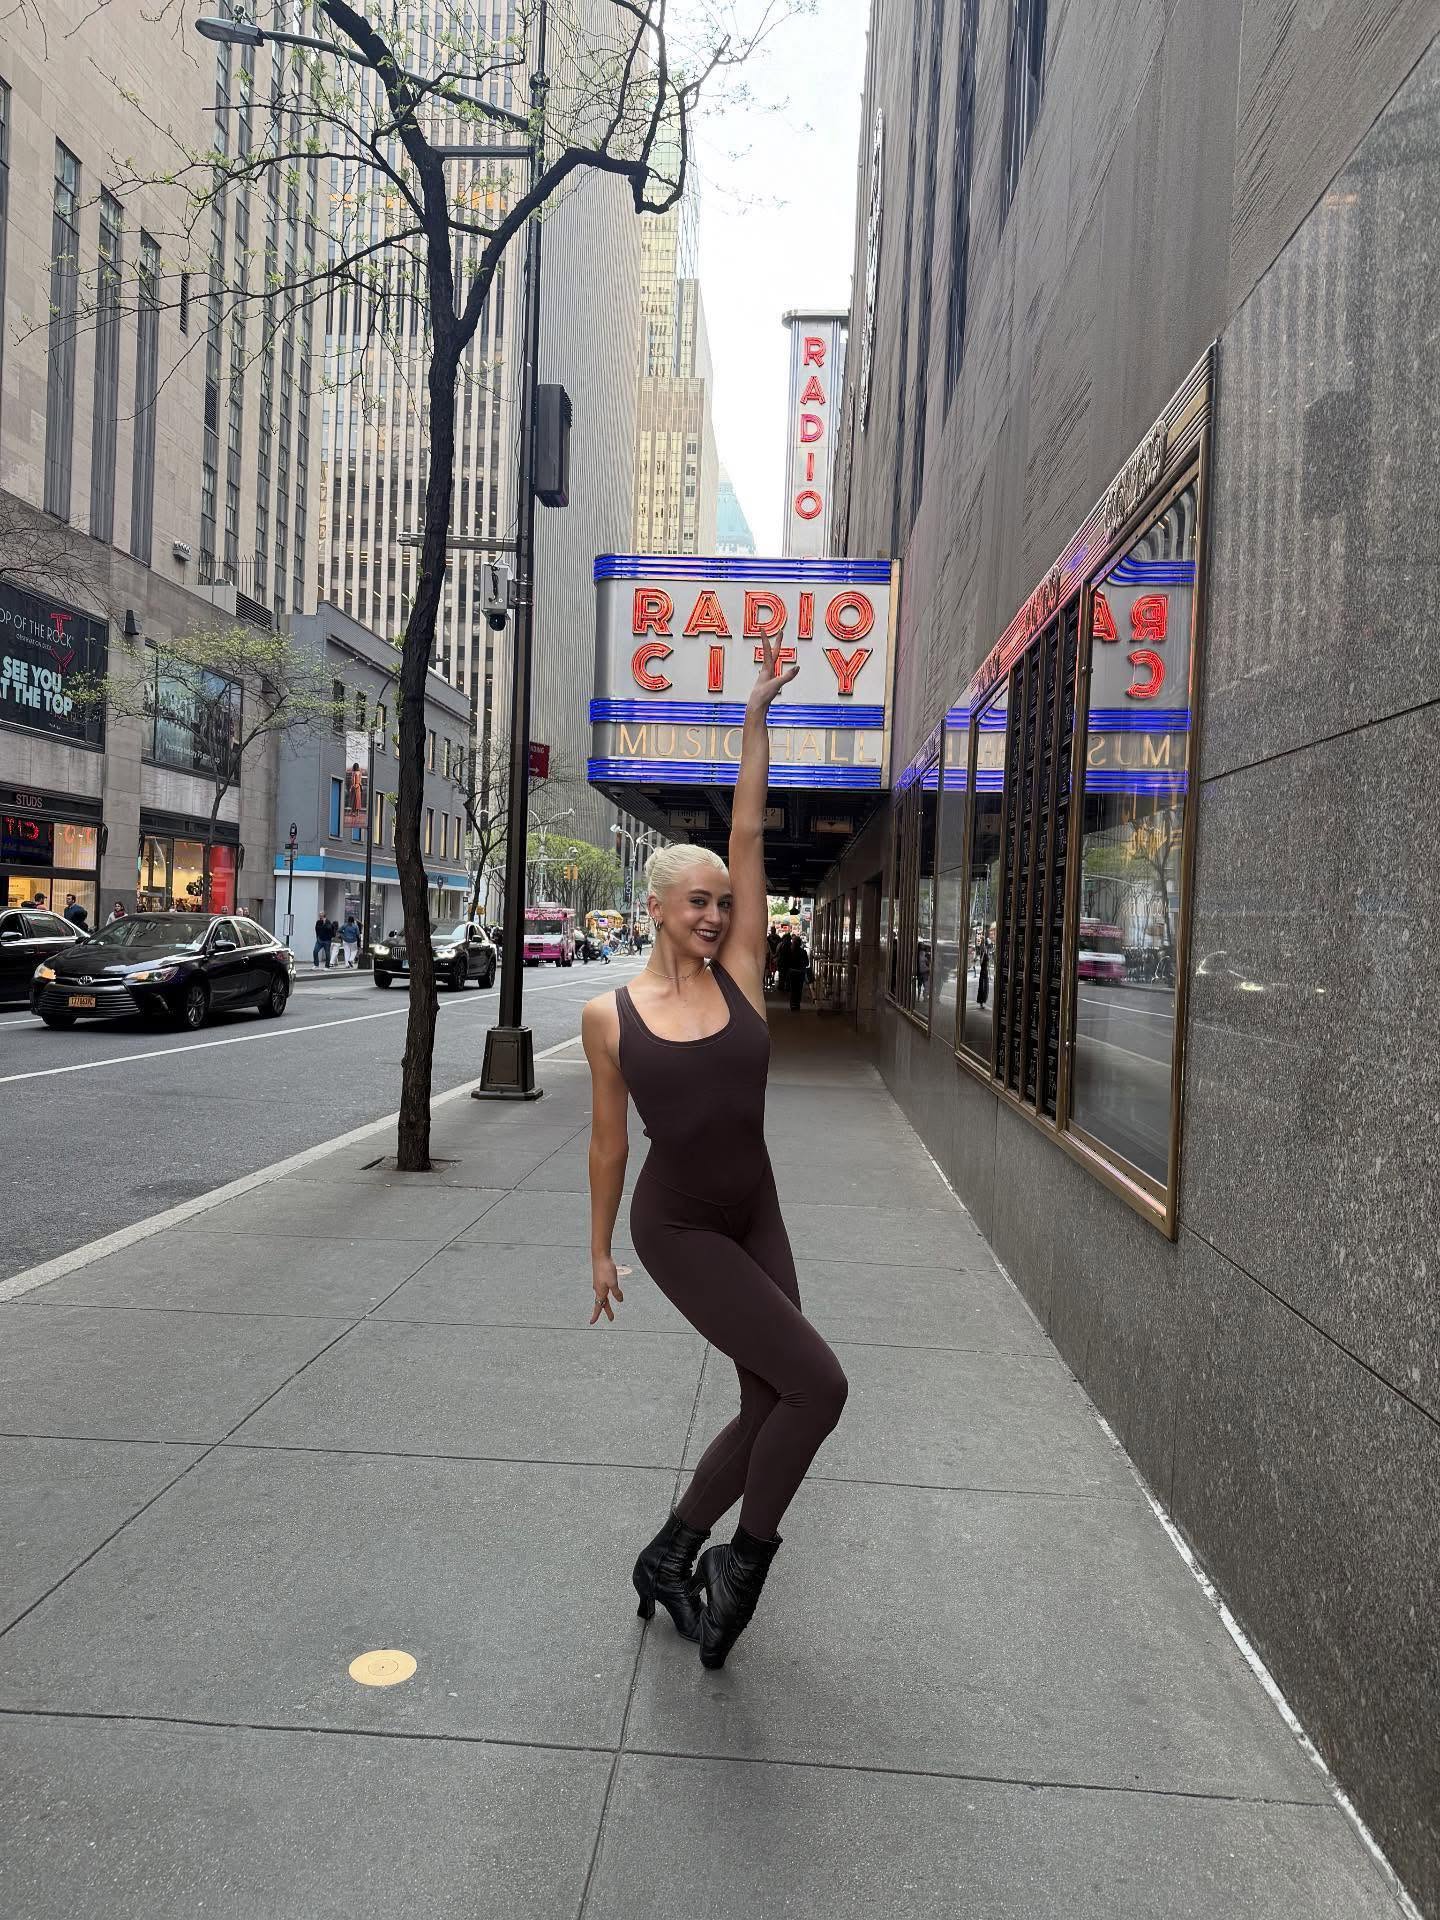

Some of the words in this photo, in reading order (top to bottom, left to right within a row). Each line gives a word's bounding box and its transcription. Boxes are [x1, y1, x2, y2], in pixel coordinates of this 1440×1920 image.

[795, 336, 827, 519] RADIO
[13, 614, 27, 631] OF
[29, 619, 45, 639] THE
[47, 627, 73, 649] ROCK
[632, 587, 875, 641] RADIO
[2, 655, 28, 683] SEE
[31, 664, 62, 693] YOU
[631, 642, 874, 696] CITY
[0, 677, 10, 700] T
[13, 681, 41, 709] THE
[44, 690, 73, 716] TOP
[618, 724, 744, 760] MUSIC
[768, 729, 877, 764] HALL
[16, 793, 43, 808] STUDS
